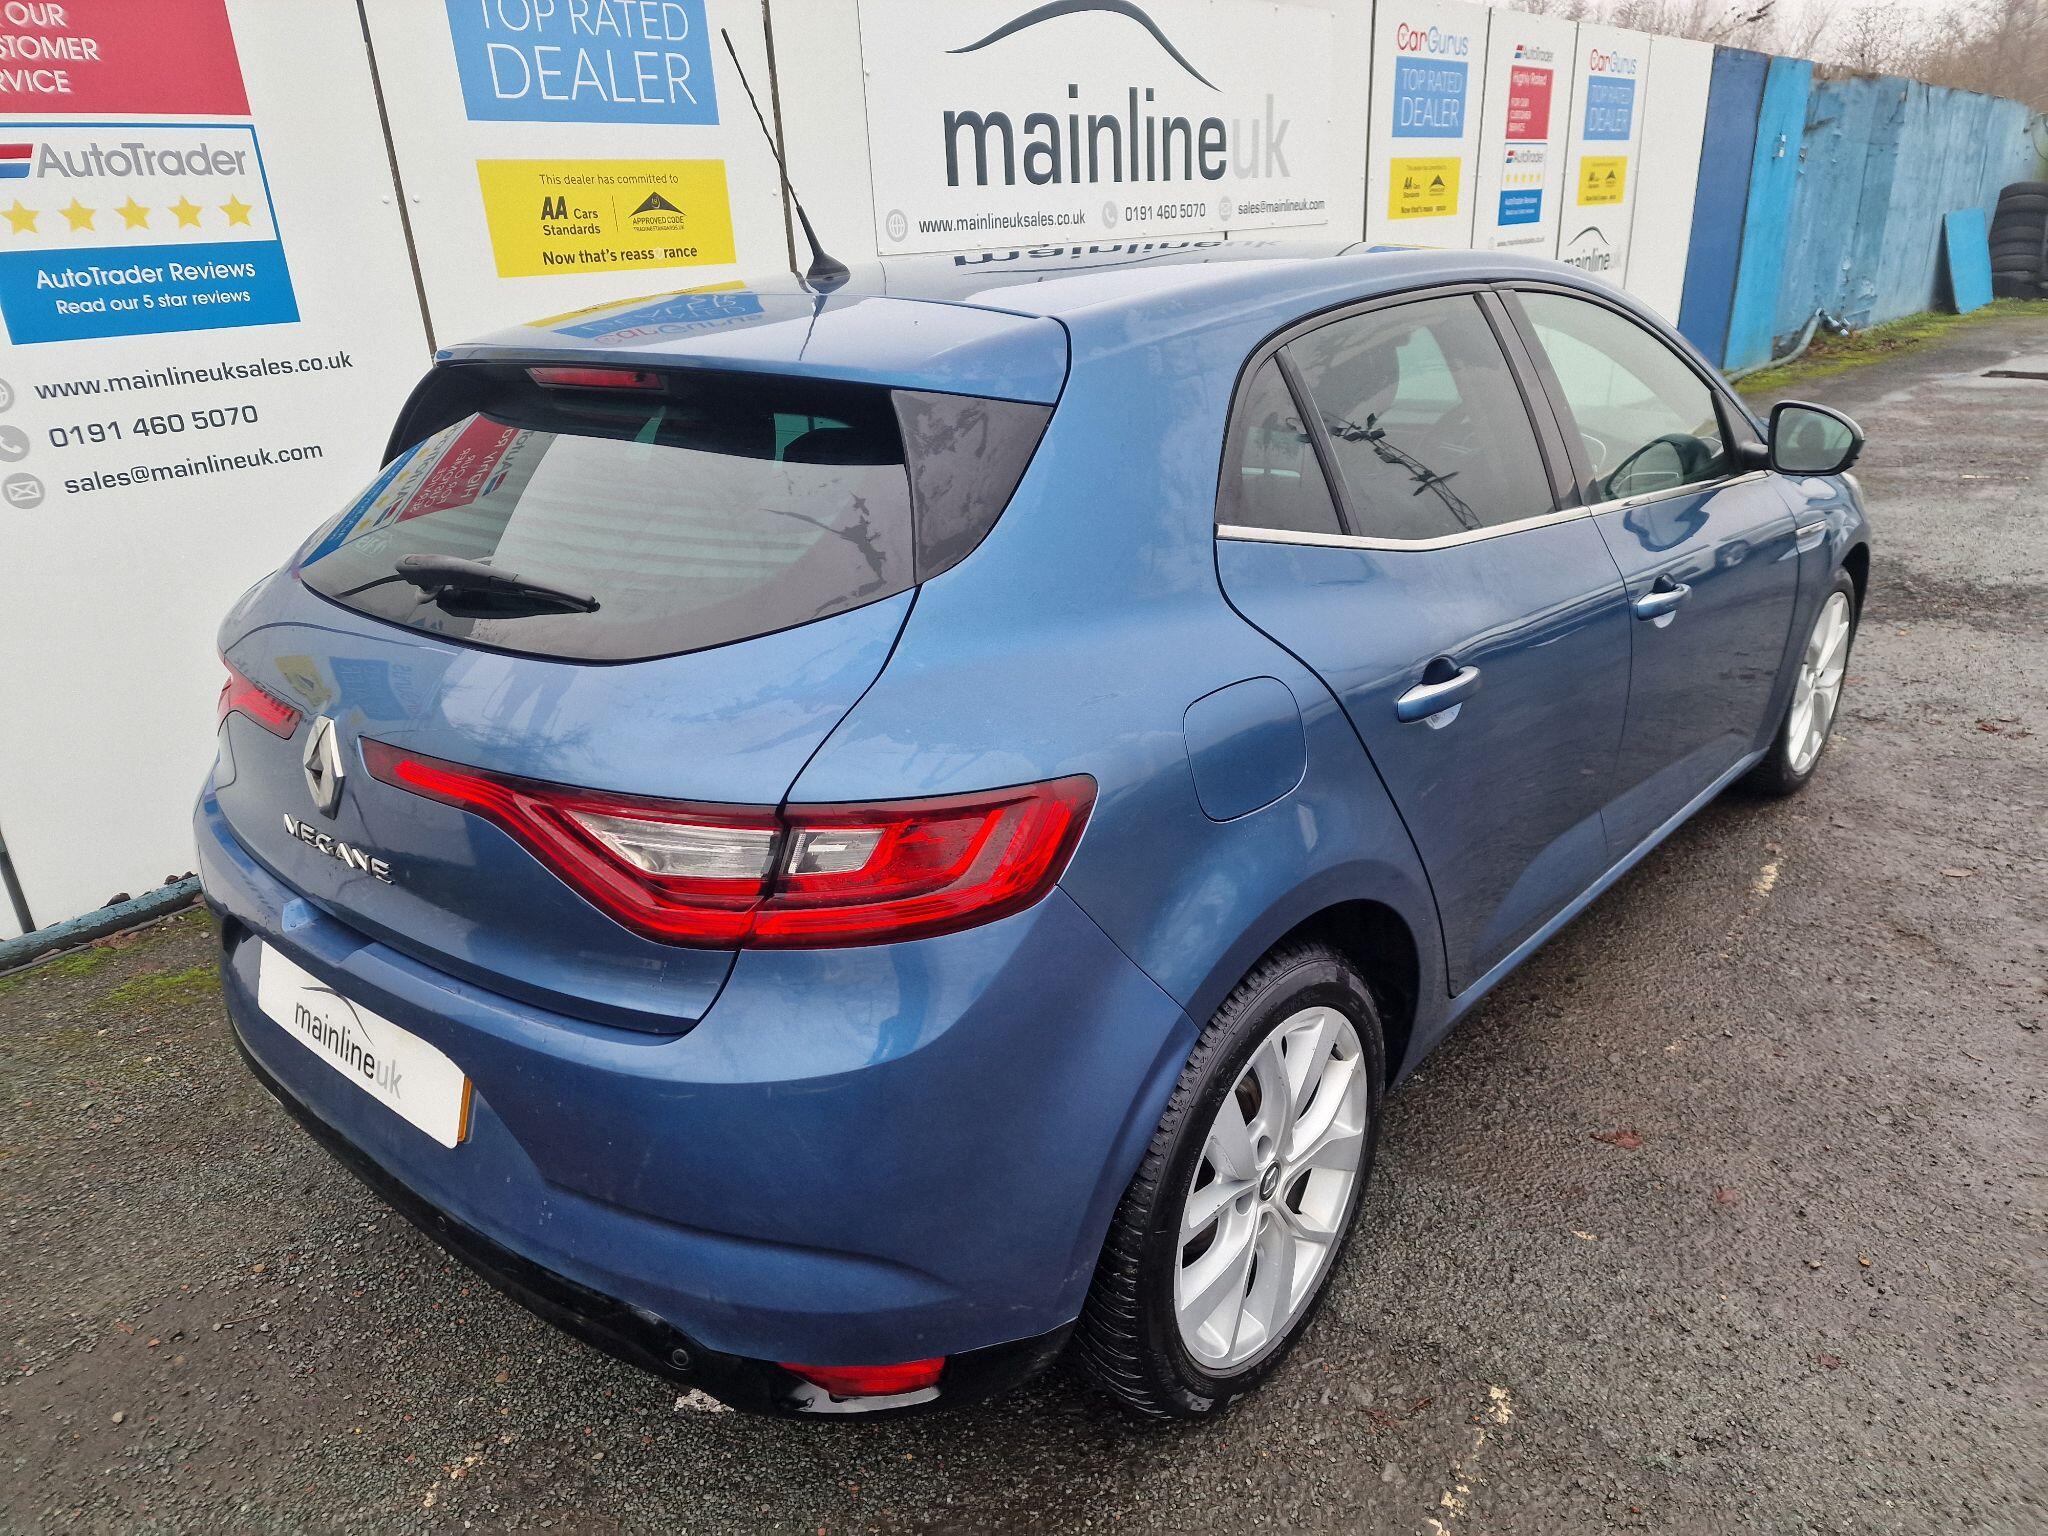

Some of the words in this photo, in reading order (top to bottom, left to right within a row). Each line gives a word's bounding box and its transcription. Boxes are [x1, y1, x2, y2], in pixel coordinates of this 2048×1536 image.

[4, 1, 67, 26] OUR
[568, 0, 688, 41] RATED
[1397, 22, 1468, 56] CarGurus
[486, 42, 697, 104] DEALER
[1590, 48, 1637, 74] CarGurus
[1401, 68, 1425, 91] TOP
[1427, 70, 1463, 93] RATED
[1401, 96, 1460, 127] DEALER
[1588, 107, 1628, 131] DEALER
[942, 83, 1291, 187] mainlineuk
[37, 142, 246, 178] AutoTrader
[539, 174, 561, 185] This
[564, 174, 594, 185] dealer
[598, 174, 614, 184] has
[617, 173, 667, 184] committed
[669, 174, 679, 184] to
[541, 196, 568, 221] AA
[573, 208, 598, 220] Cars
[1125, 205, 1153, 221] 0191
[1156, 204, 1177, 220] 460
[1180, 203, 1206, 218] 5070
[1238, 198, 1325, 215] sales@mainlineuk.com
[543, 223, 601, 236] Standards
[633, 217, 666, 226] APPROVED
[667, 216, 684, 224] CODE
[918, 209, 1086, 233] www.mainlineuksales.co.uk
[542, 250, 576, 265] Now
[579, 249, 617, 264] that's
[620, 247, 698, 262] reassrance
[36, 264, 164, 290] AutoTrader
[168, 260, 257, 282] Reviews
[56, 298, 106, 315] Read
[110, 296, 139, 311] our
[144, 294, 154, 309] 5
[158, 292, 188, 308] star
[192, 289, 251, 306] reviews
[34, 351, 354, 400] www.mainlineuksales.co.uk
[49, 420, 122, 448] 0191
[132, 413, 185, 437] 460
[192, 404, 259, 431] 5070
[64, 444, 323, 494] sales@mainlineuk.com
[284, 812, 395, 885] MEGANE
[294, 1001, 403, 1099] mainlineuk
